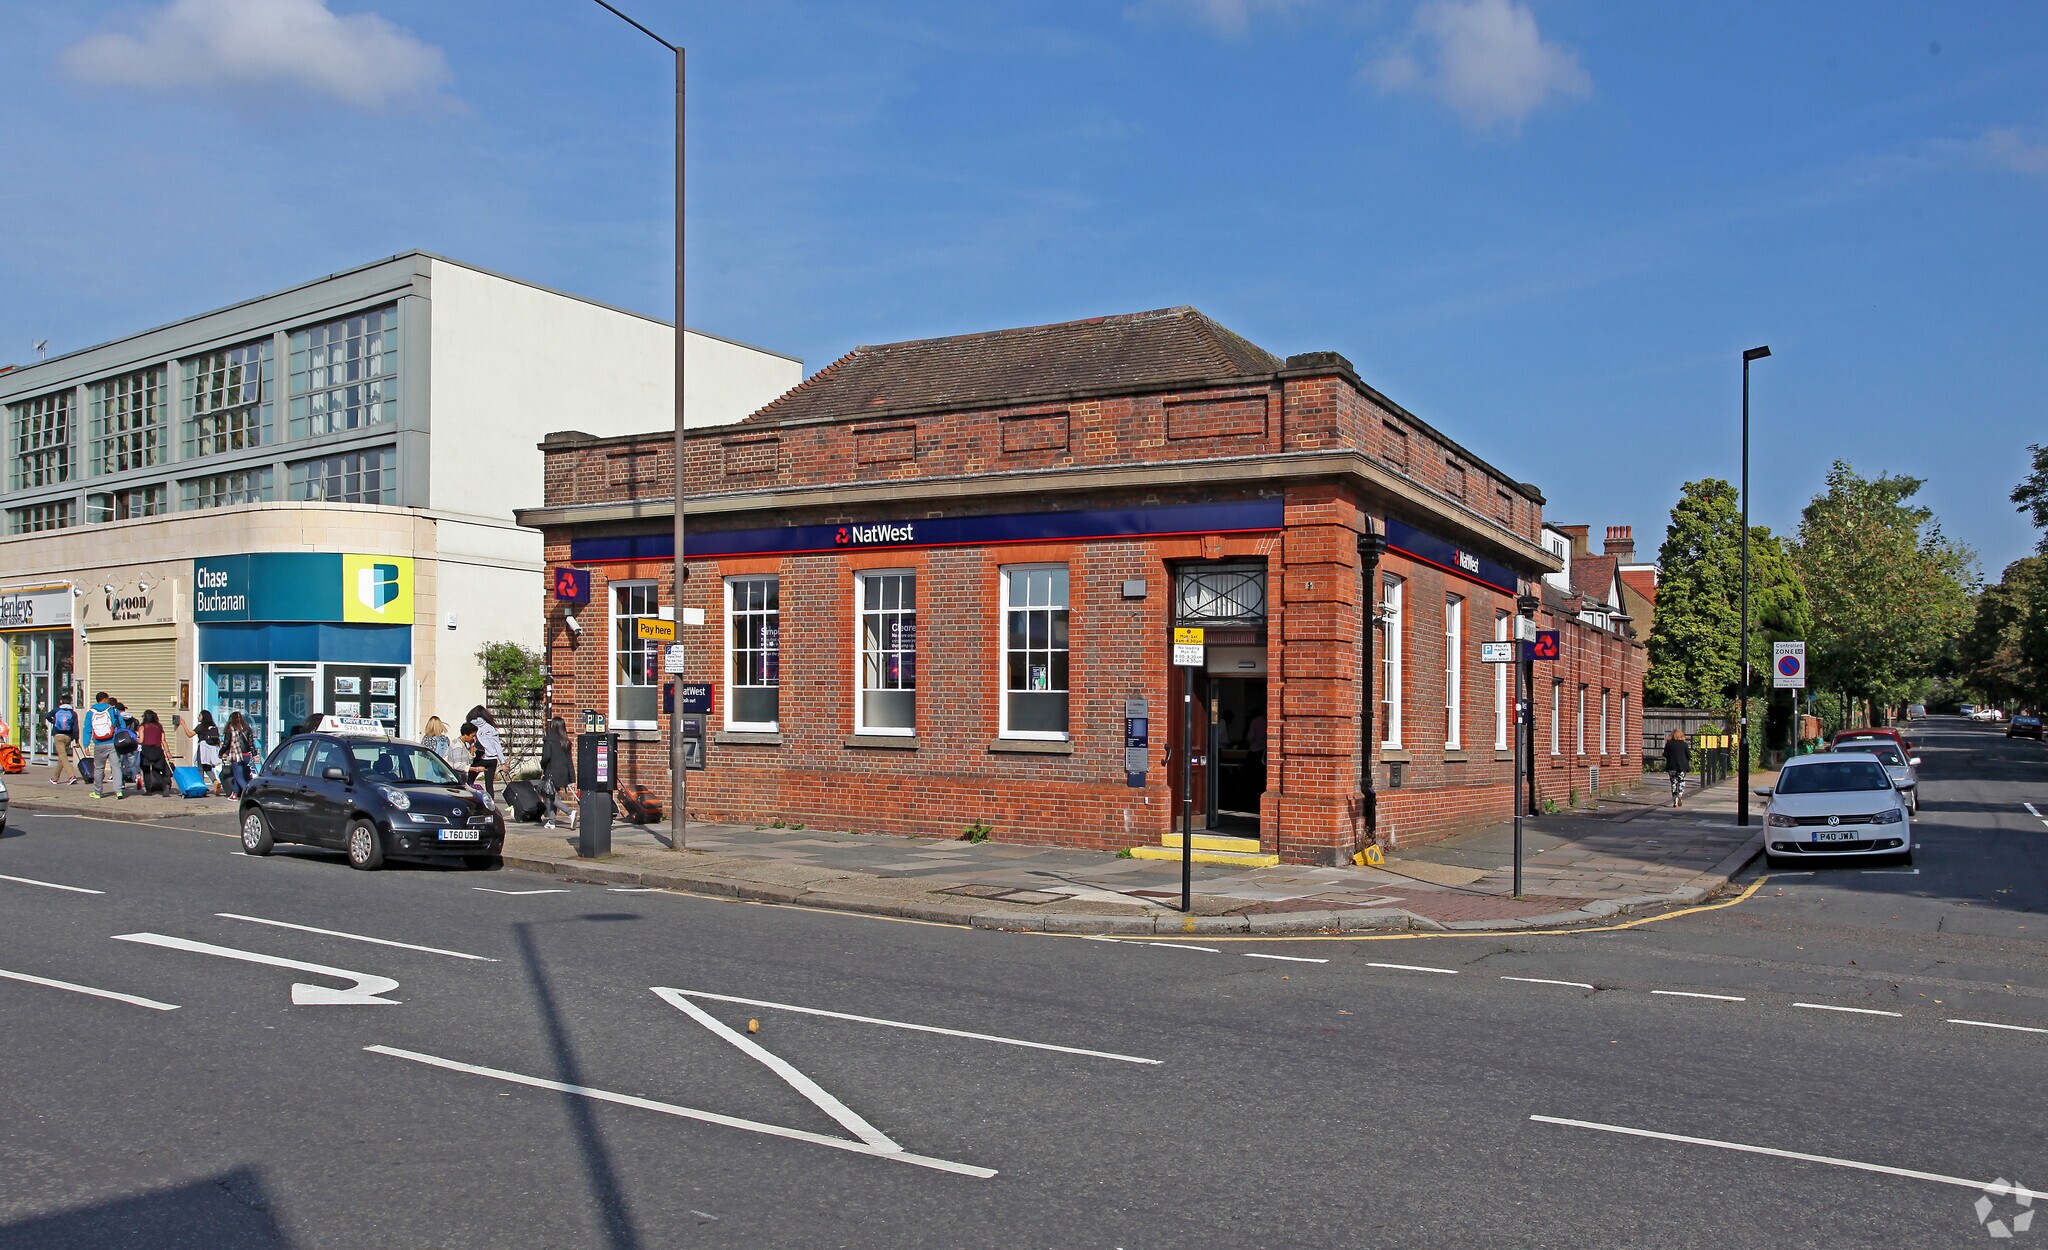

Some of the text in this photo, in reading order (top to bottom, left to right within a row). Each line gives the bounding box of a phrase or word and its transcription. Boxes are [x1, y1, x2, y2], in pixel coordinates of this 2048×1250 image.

[852, 523, 914, 543] NatWest
[1460, 550, 1478, 573] NatWest
[198, 567, 228, 588] Chase
[106, 593, 147, 611] Cocoon
[198, 590, 245, 611] Buchanan
[640, 623, 671, 635] Pay here
[683, 687, 706, 696] atWest
[330, 719, 339, 728] L
[598, 714, 604, 725] P
[443, 831, 478, 839] LT60 USB
[1820, 833, 1837, 841] P40
